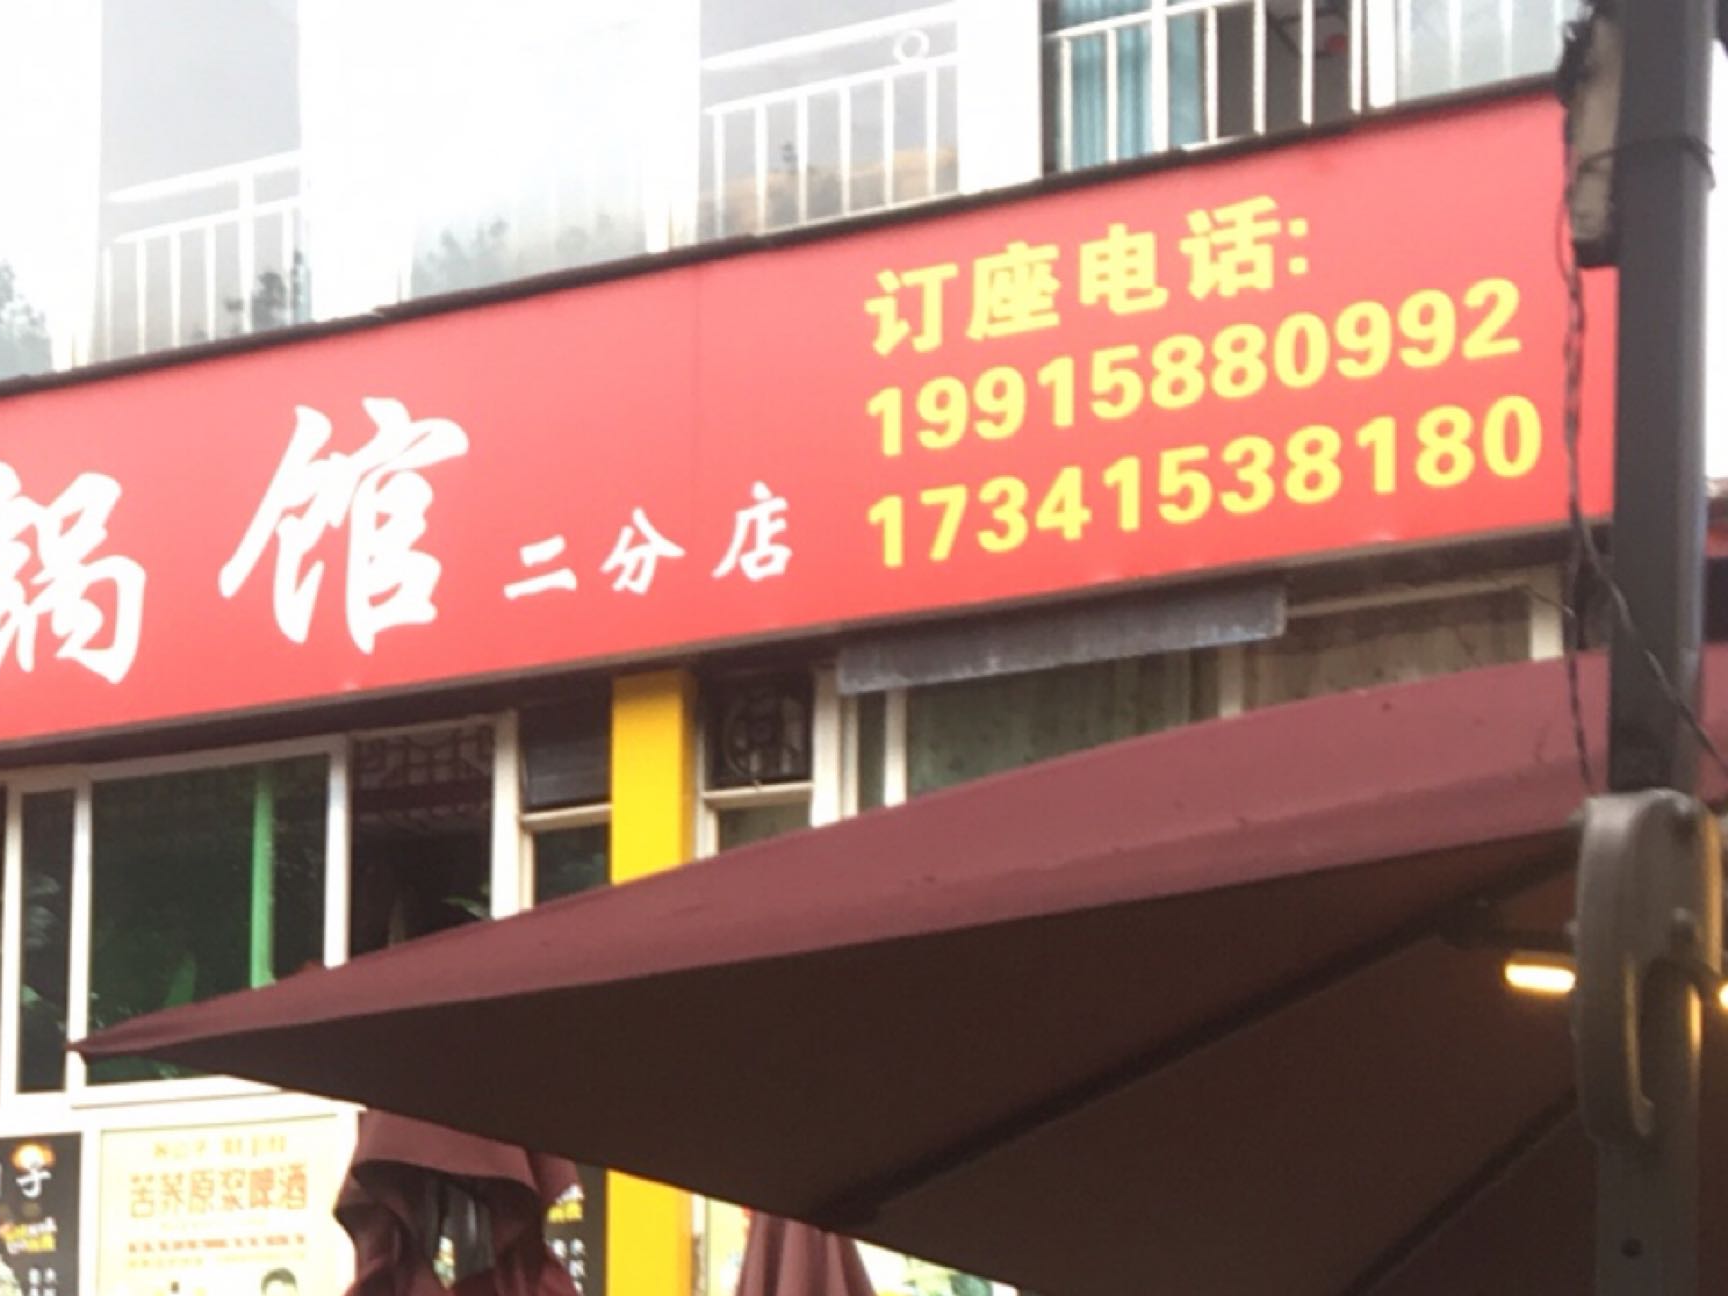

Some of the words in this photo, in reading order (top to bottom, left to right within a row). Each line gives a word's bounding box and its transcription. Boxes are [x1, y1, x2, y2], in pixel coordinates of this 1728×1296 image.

[864, 195, 1309, 356] 订座电话:
[866, 277, 1522, 457] 19915880992
[502, 480, 792, 600] 二分店
[867, 394, 1543, 568] 17341538180
